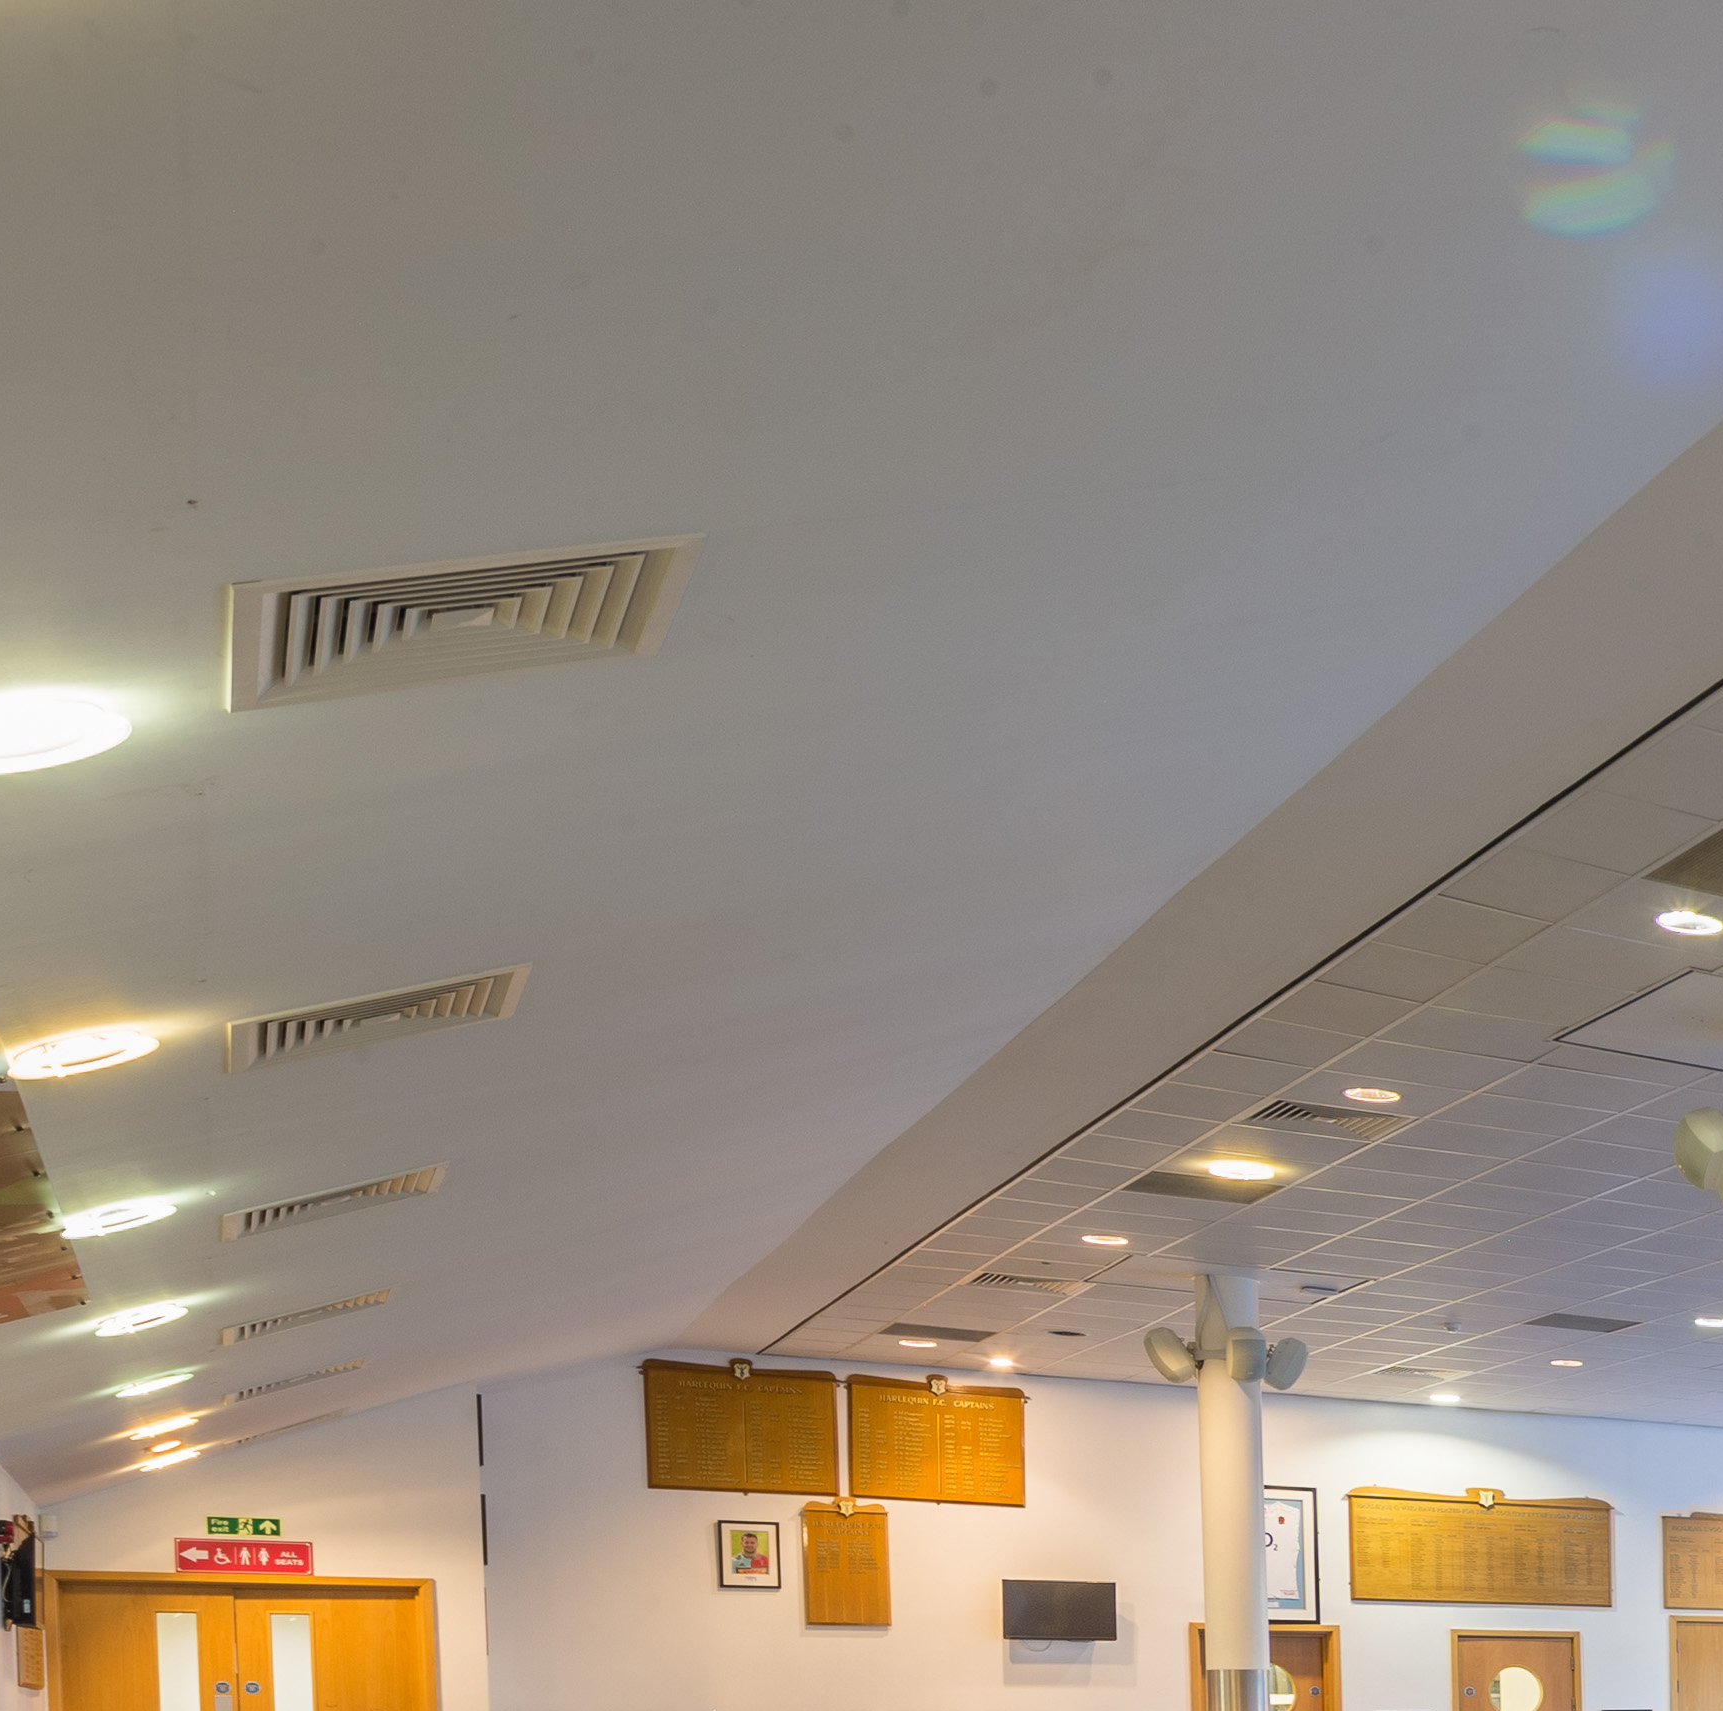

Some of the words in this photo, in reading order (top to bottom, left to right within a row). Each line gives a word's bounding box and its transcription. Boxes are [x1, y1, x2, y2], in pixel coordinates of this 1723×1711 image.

[879, 1393, 929, 1405] HARLEQUIN
[953, 1399, 995, 1410] CAPTAINS
[274, 1558, 304, 1566] SEATS
